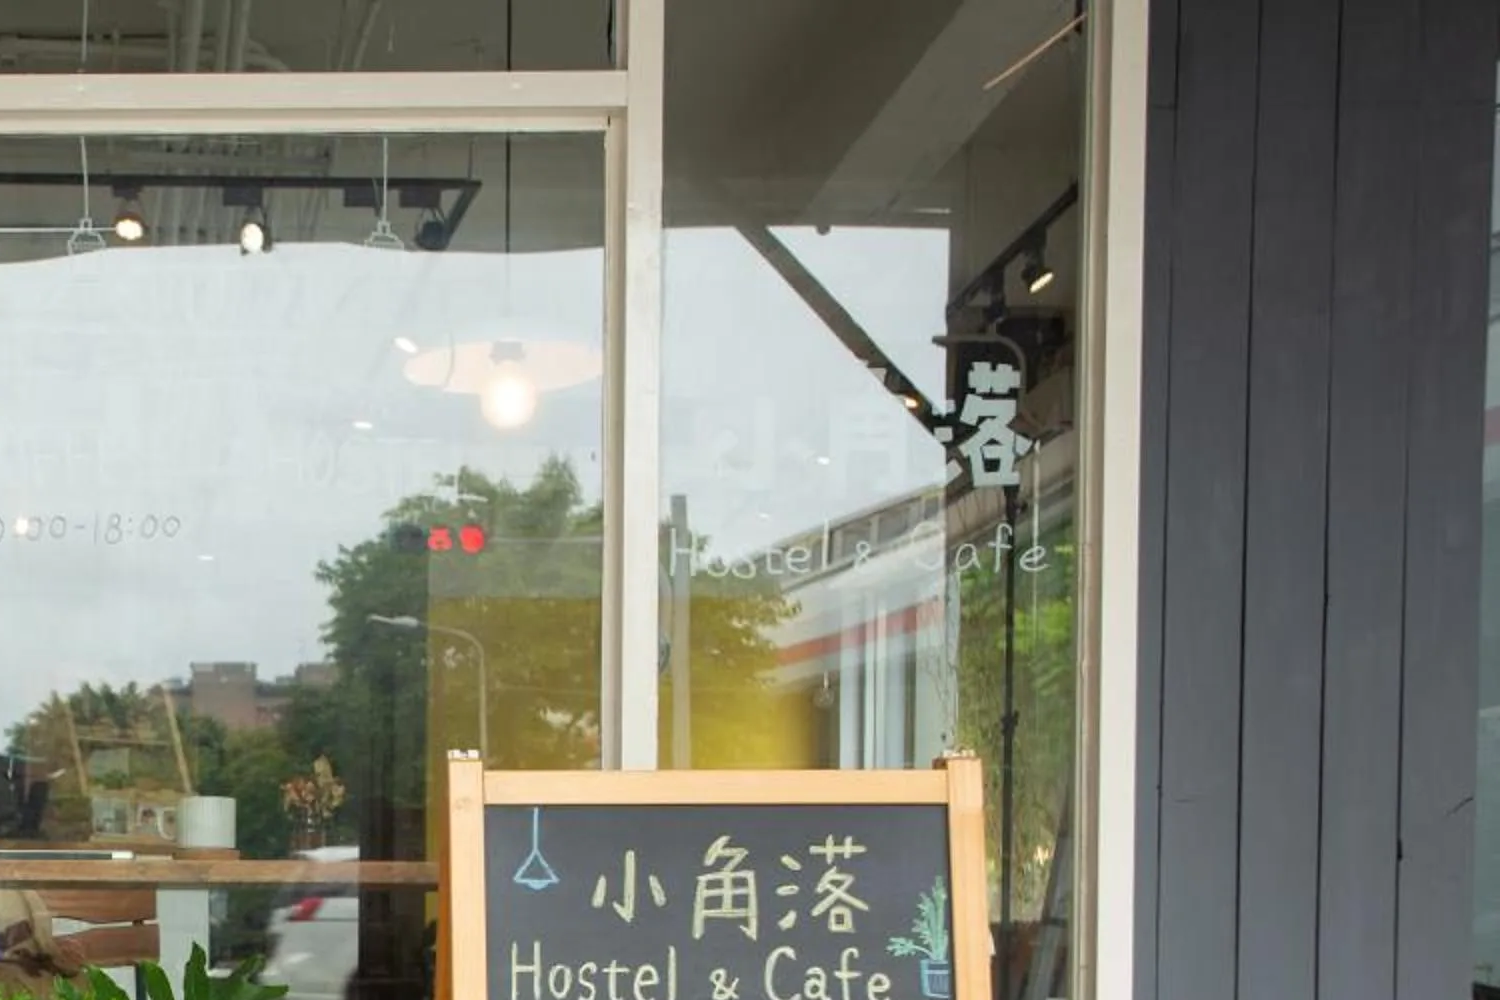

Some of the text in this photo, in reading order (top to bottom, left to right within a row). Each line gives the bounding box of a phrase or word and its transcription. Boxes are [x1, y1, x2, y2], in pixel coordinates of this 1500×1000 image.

[668, 518, 1052, 579] Hostel & Cafe
[591, 835, 870, 941] 小角落
[708, 967, 741, 1000] &
